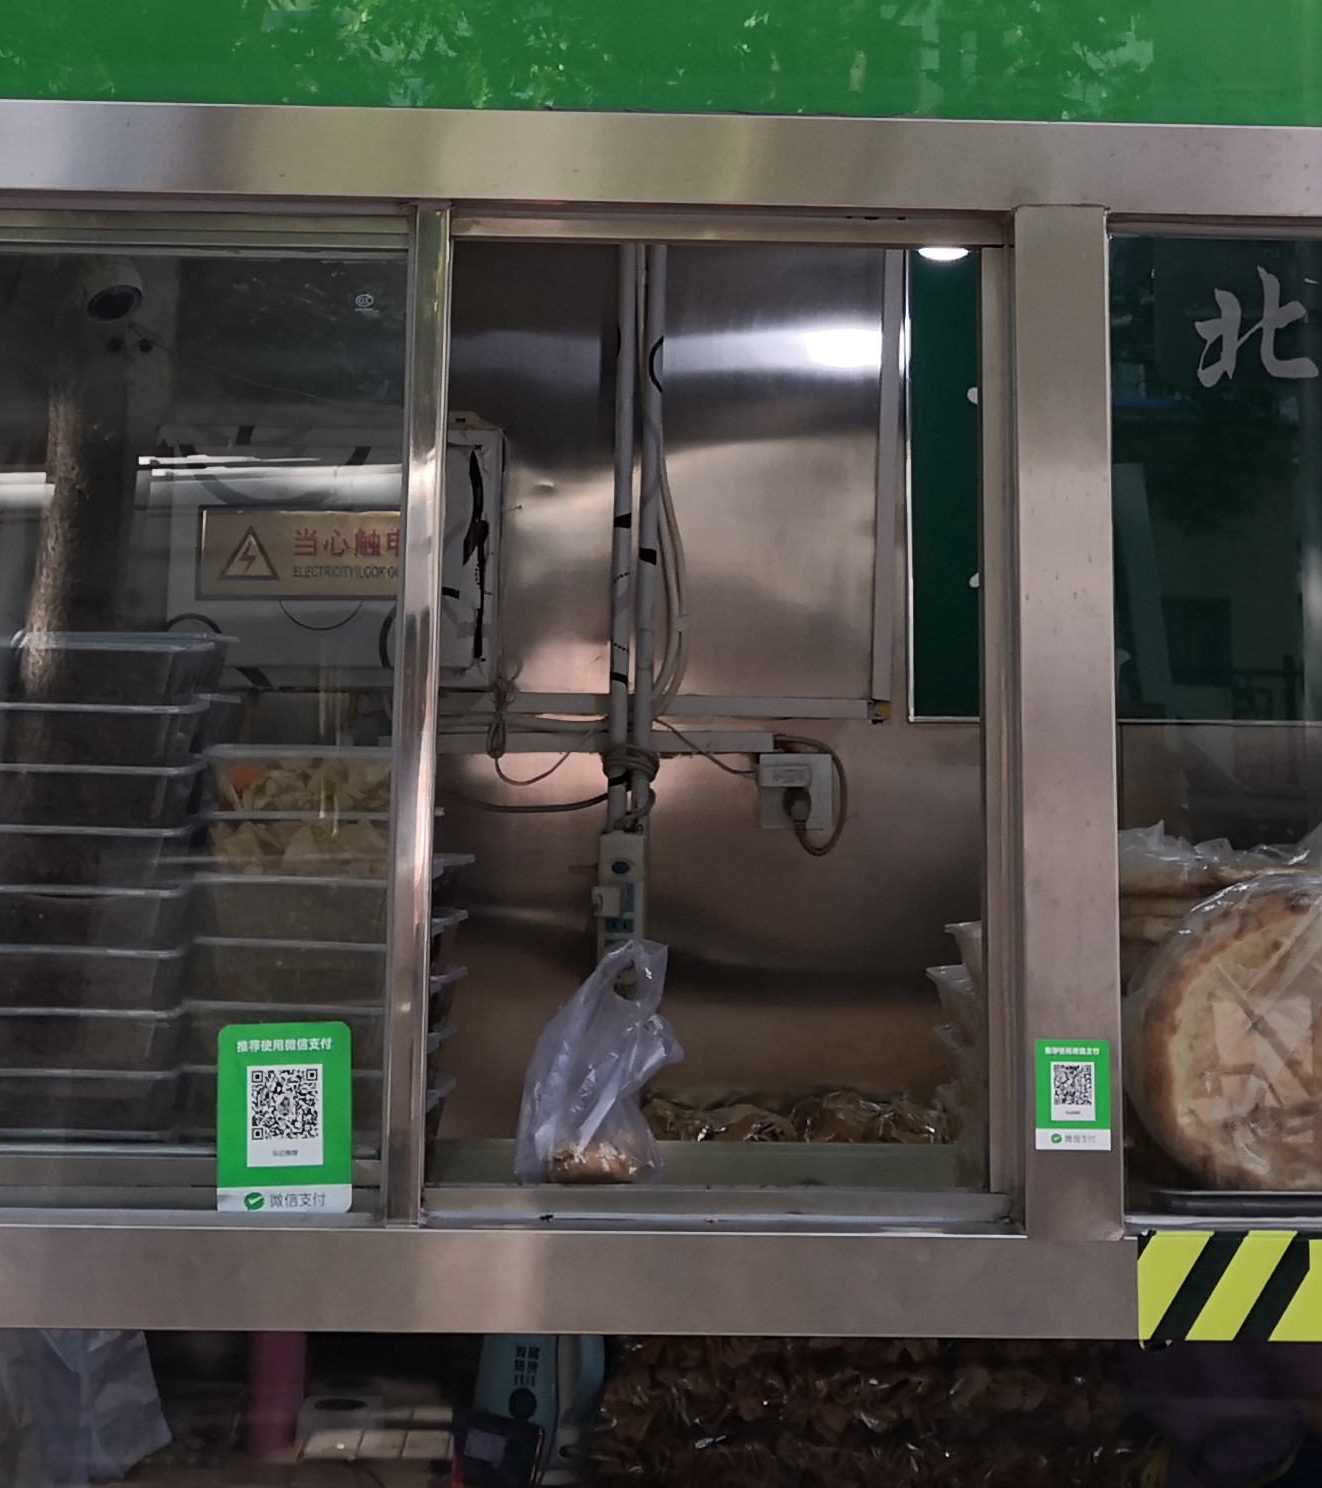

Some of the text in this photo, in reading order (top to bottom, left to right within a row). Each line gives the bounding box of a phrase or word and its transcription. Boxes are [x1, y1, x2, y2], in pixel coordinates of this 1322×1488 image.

[236, 1038, 333, 1053] 推荐使用微信支付
[270, 1192, 326, 1208] 微信支付
